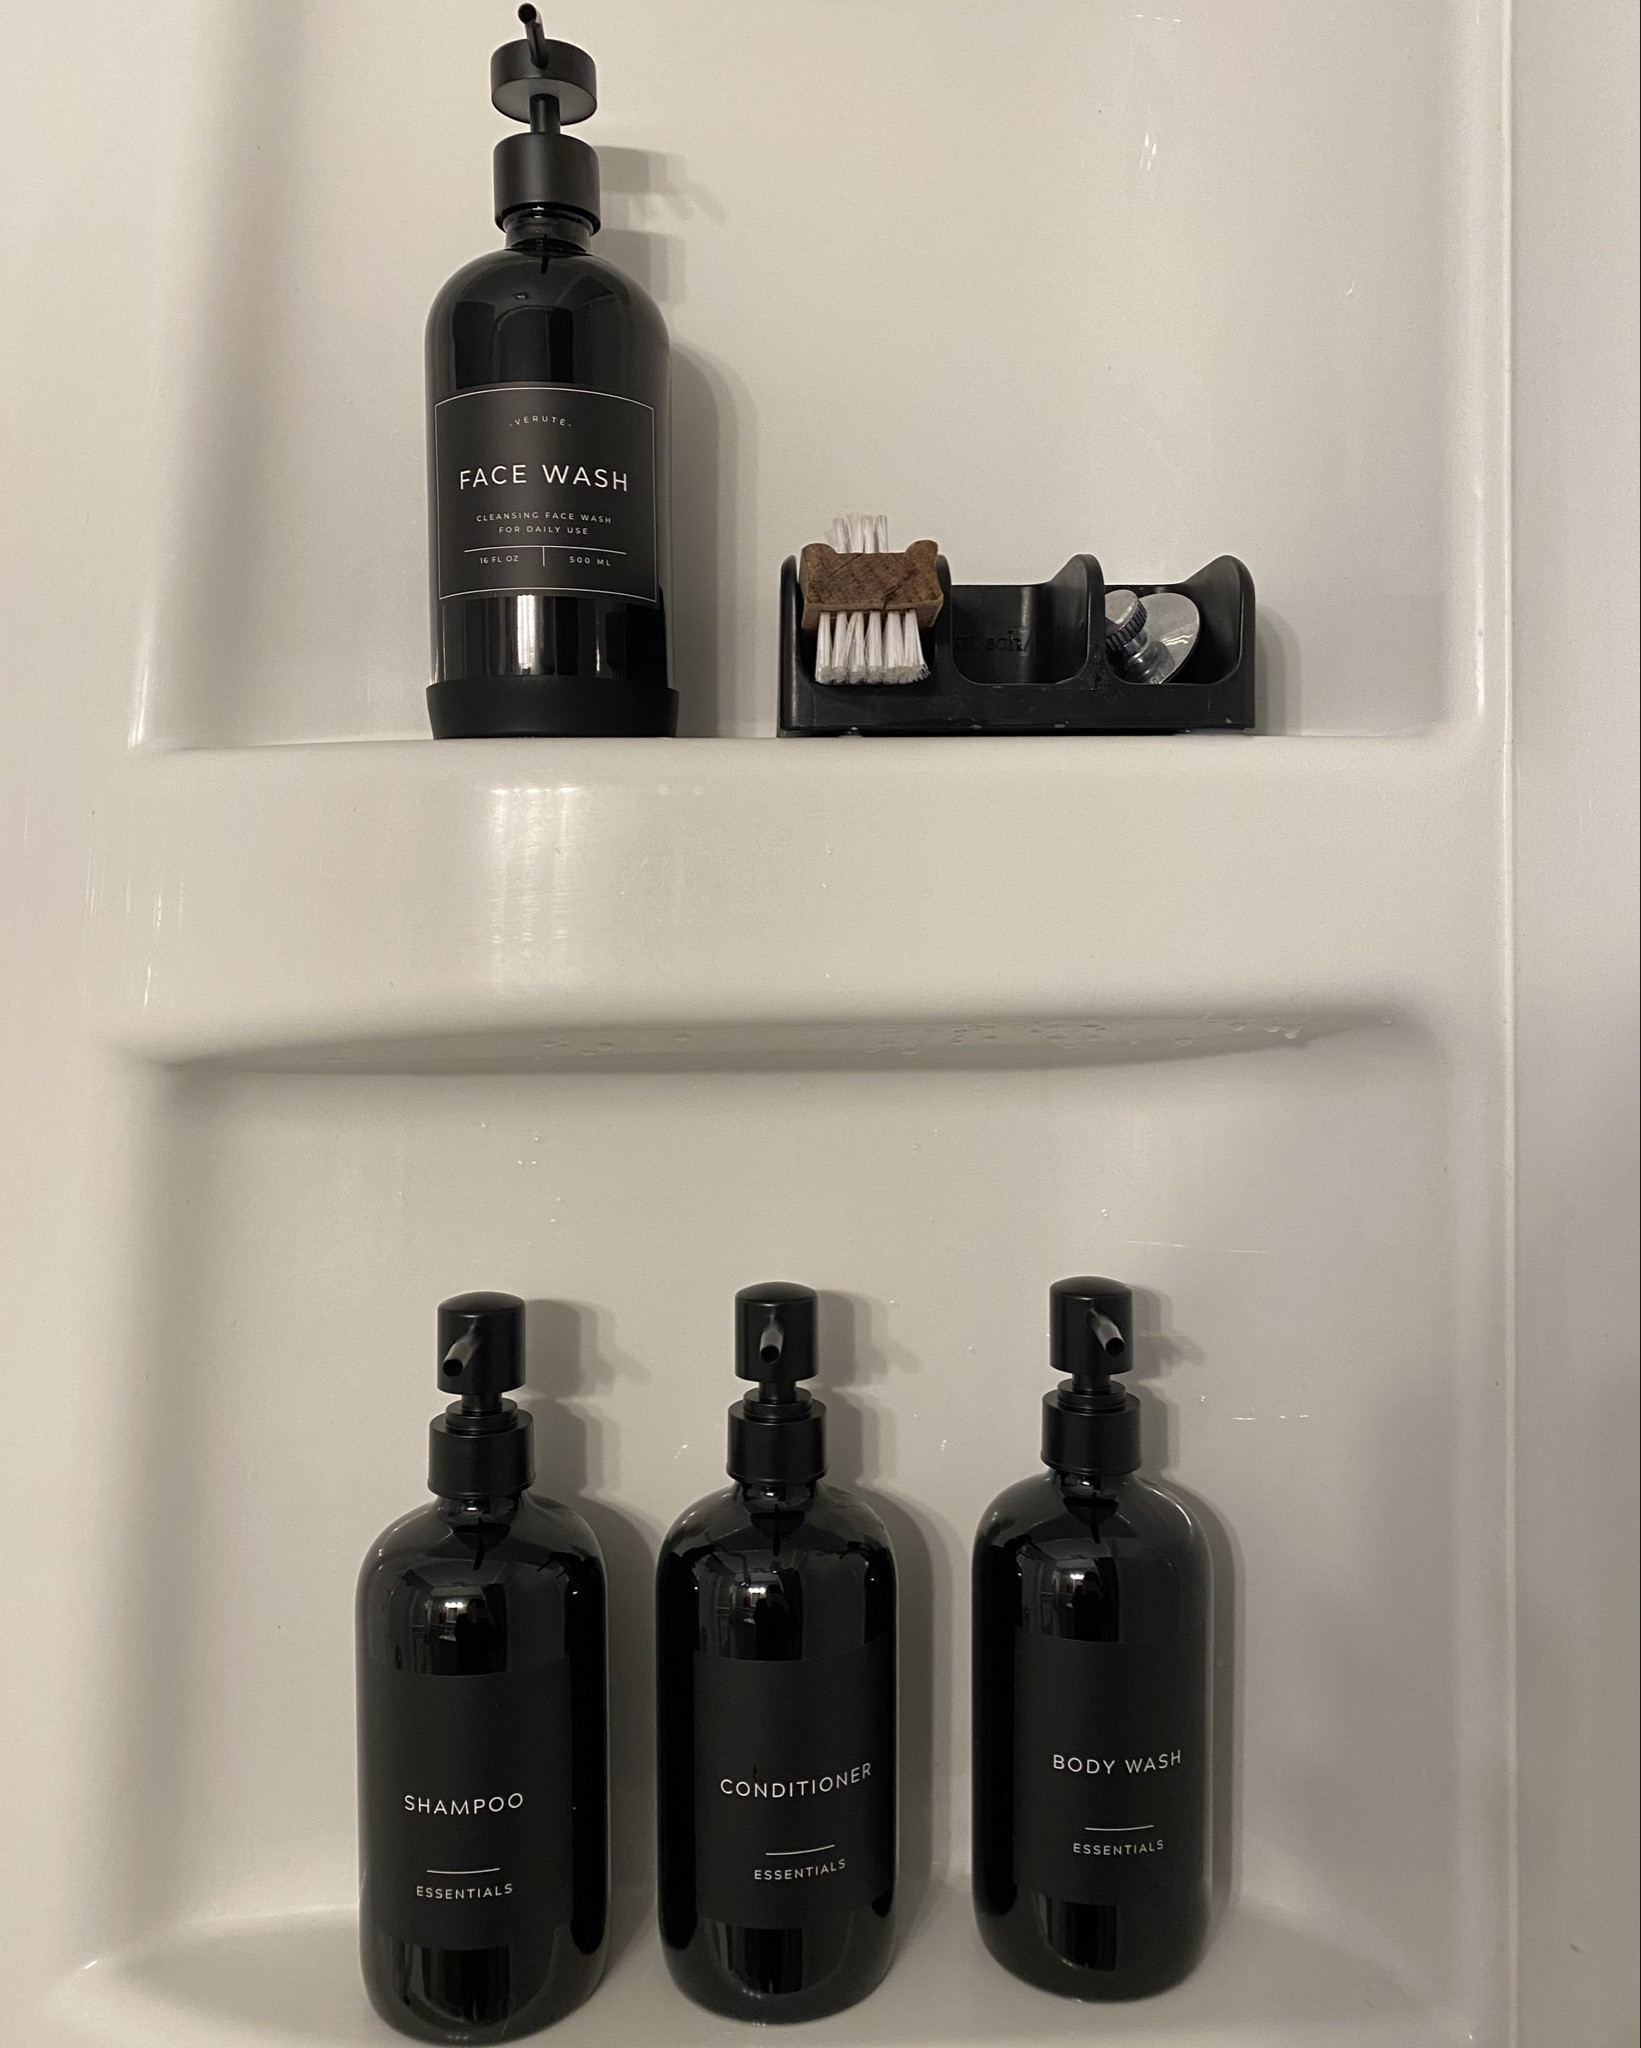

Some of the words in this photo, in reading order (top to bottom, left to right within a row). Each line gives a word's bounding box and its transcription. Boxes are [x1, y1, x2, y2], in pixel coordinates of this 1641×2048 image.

[460, 464, 527, 490] FACE
[541, 464, 628, 492] WASH
[476, 511, 539, 522] CLEANSING
[545, 511, 574, 520] FACE
[580, 514, 611, 524] WASH
[498, 526, 520, 534] FOR
[526, 525, 561, 533] DAILY
[567, 527, 588, 535] USE
[505, 554, 519, 563] OZ
[569, 556, 591, 564] 500
[596, 558, 611, 567] ML
[1053, 1754, 1116, 1775] BODY
[1124, 1749, 1181, 1774] WASH
[720, 1762, 871, 1798] CONDITIONER
[404, 1792, 524, 1815] SHAMPOO
[1073, 1839, 1164, 1856] ESSENTIALS
[754, 1858, 846, 1881] ESSENTIALS
[416, 1883, 513, 1900] ESSENTIALS
